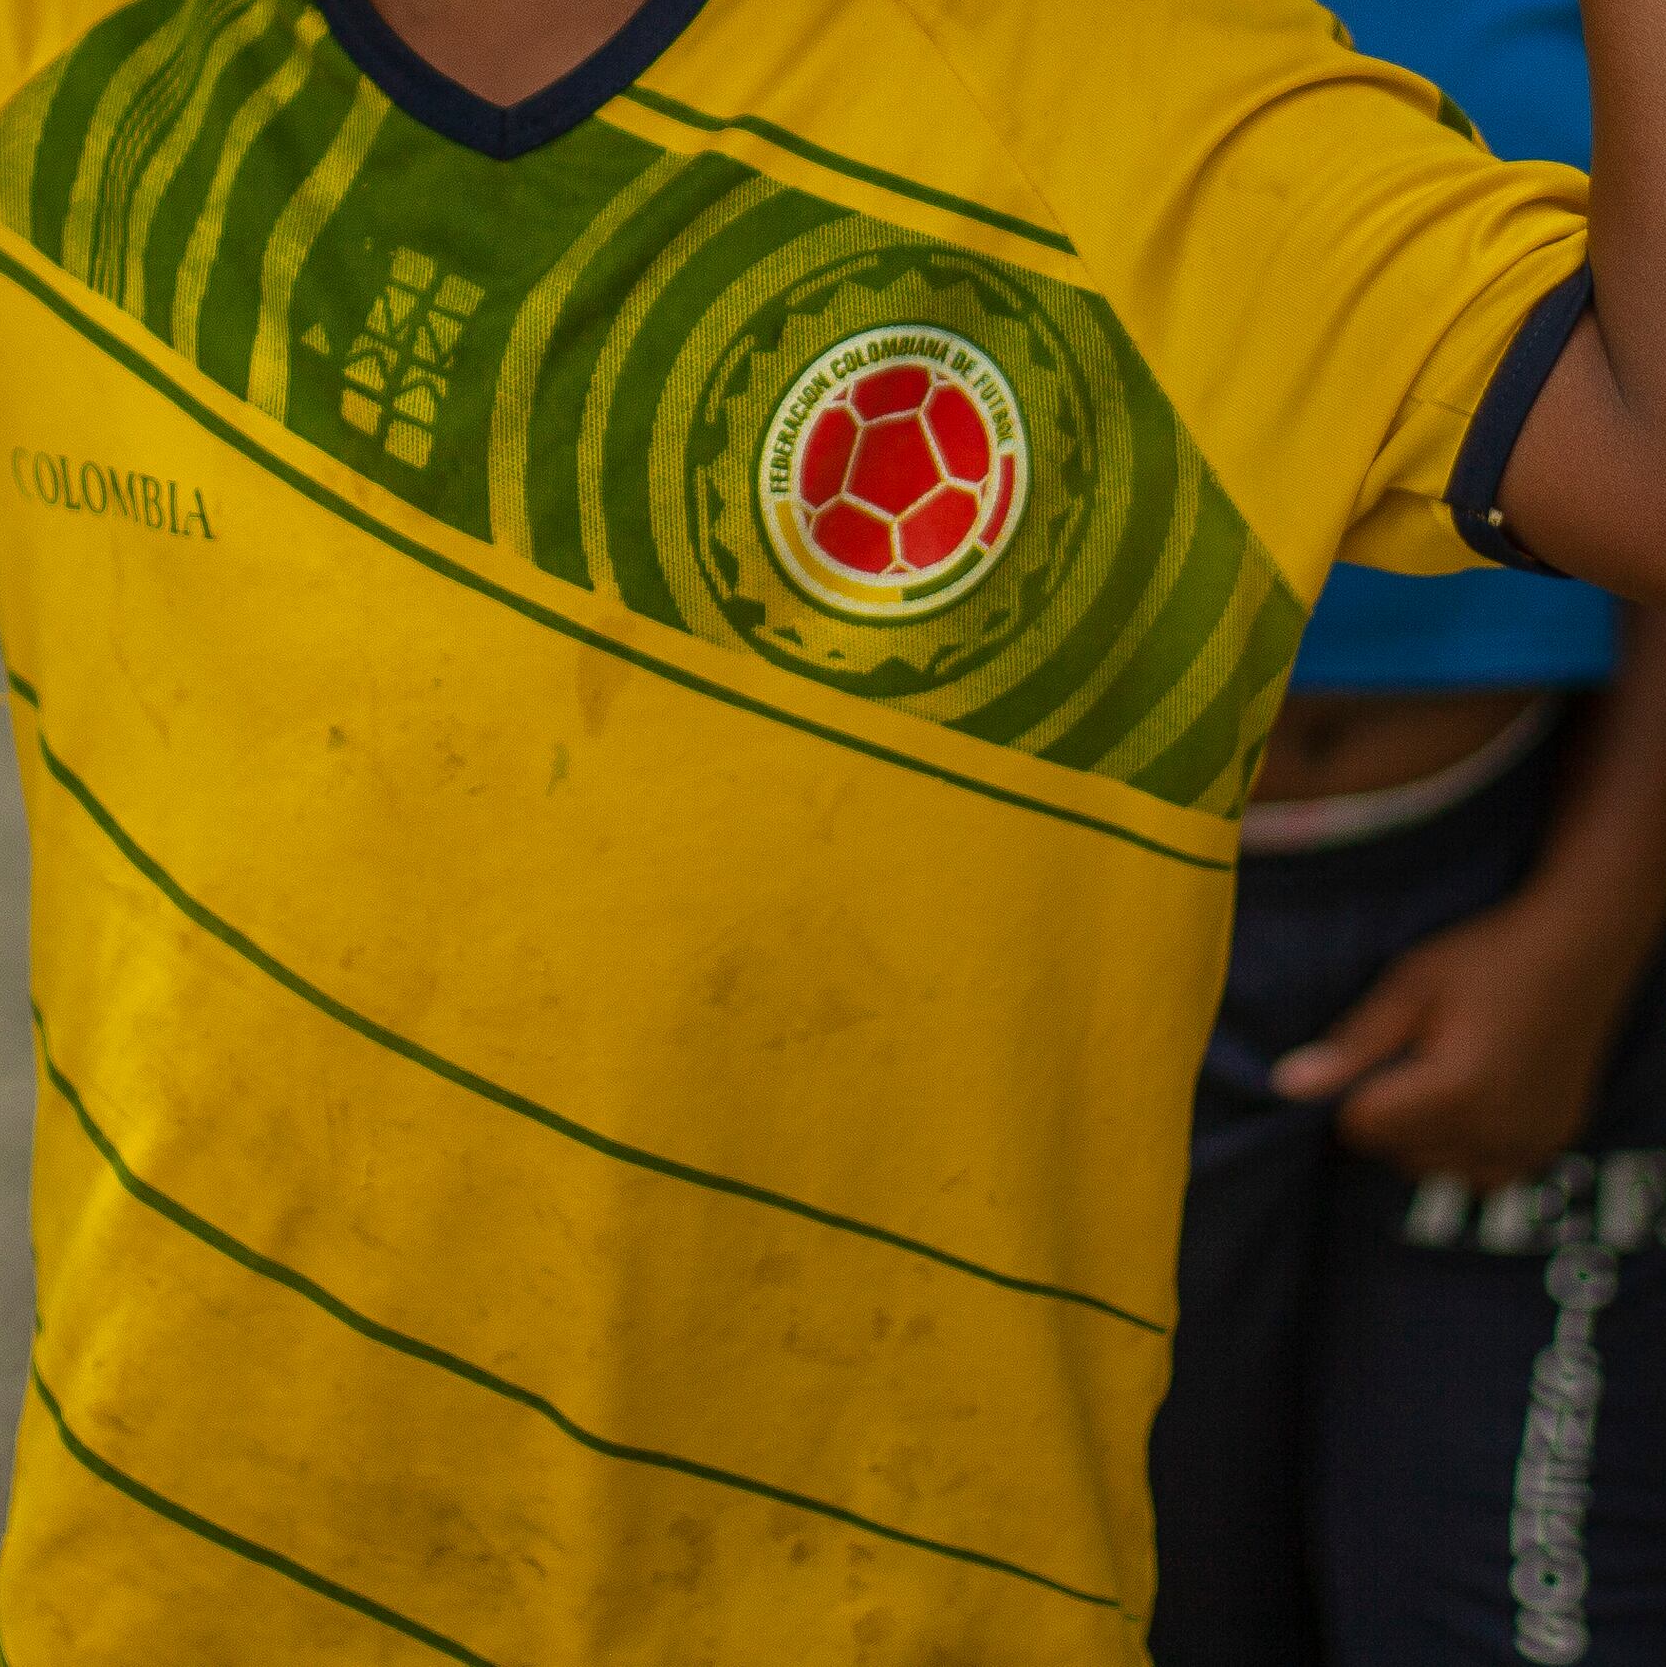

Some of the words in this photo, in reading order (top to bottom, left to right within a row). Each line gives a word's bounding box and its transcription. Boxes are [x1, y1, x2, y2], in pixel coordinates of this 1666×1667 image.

[830, 335, 950, 379] COLOMBIANA
[951, 348, 977, 377] DE
[972, 370, 1014, 447] FUTBOL
[12, 446, 214, 540] COLOMBIA
